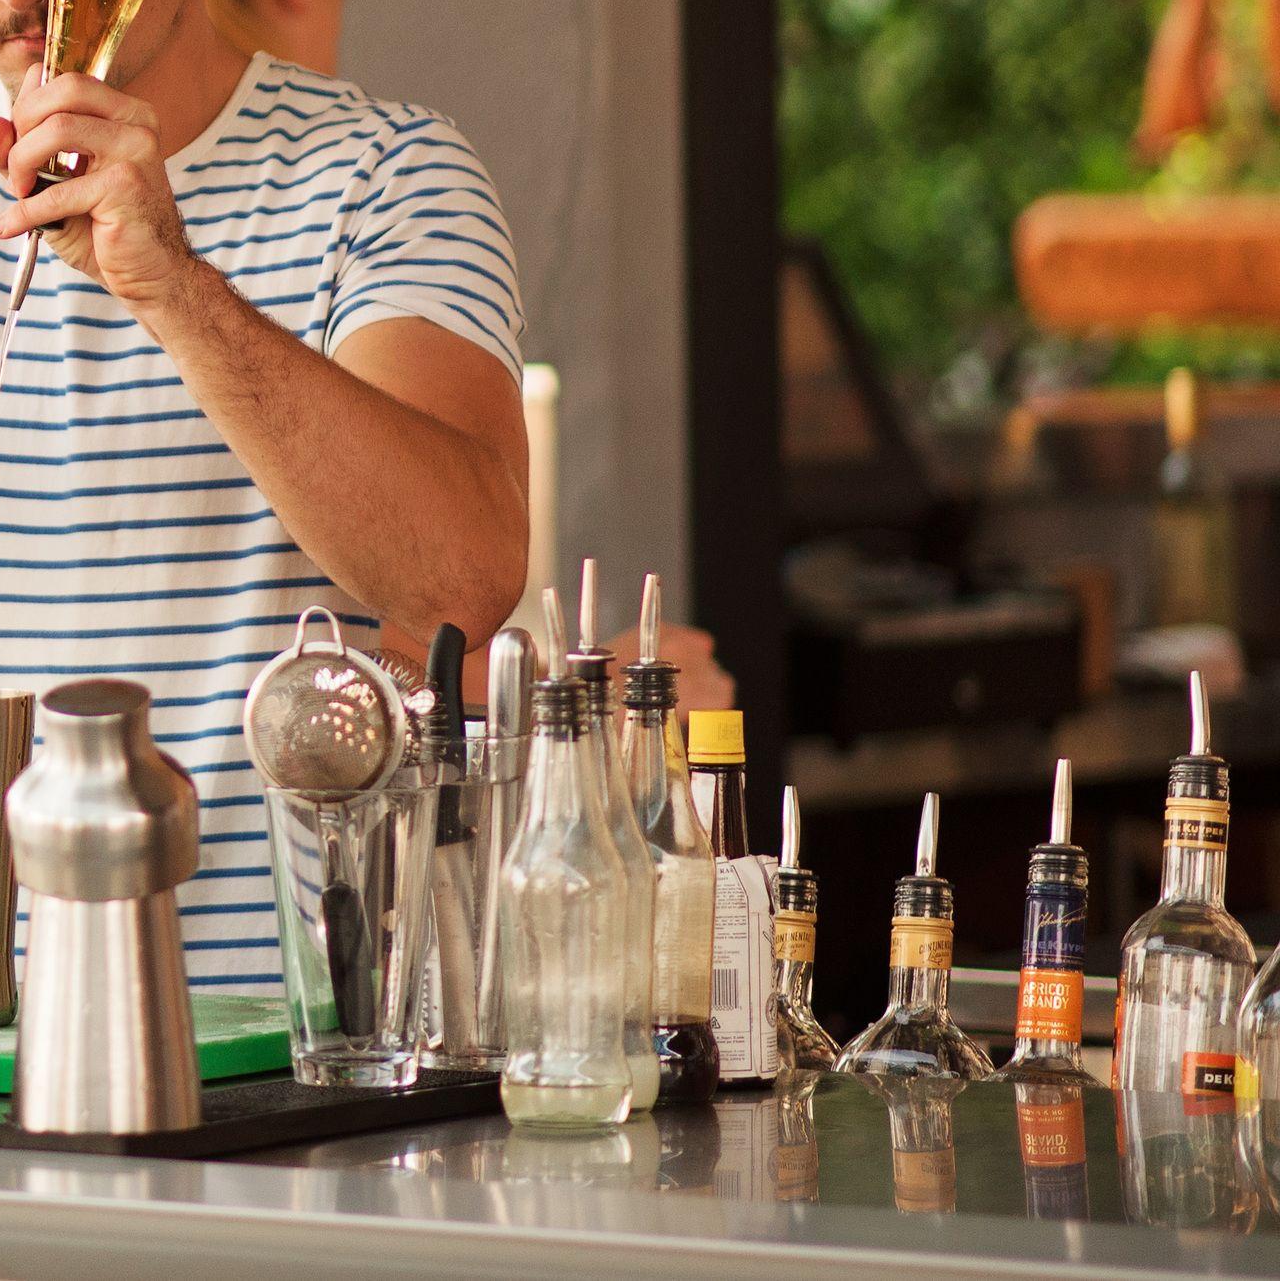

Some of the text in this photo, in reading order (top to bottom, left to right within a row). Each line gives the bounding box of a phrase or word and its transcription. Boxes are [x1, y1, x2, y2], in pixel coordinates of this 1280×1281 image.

[1182, 822, 1225, 836] KUYPER
[1023, 981, 1071, 997] APRICOT
[1022, 995, 1070, 1010] BRANDY
[1204, 1073, 1222, 1084] DE
